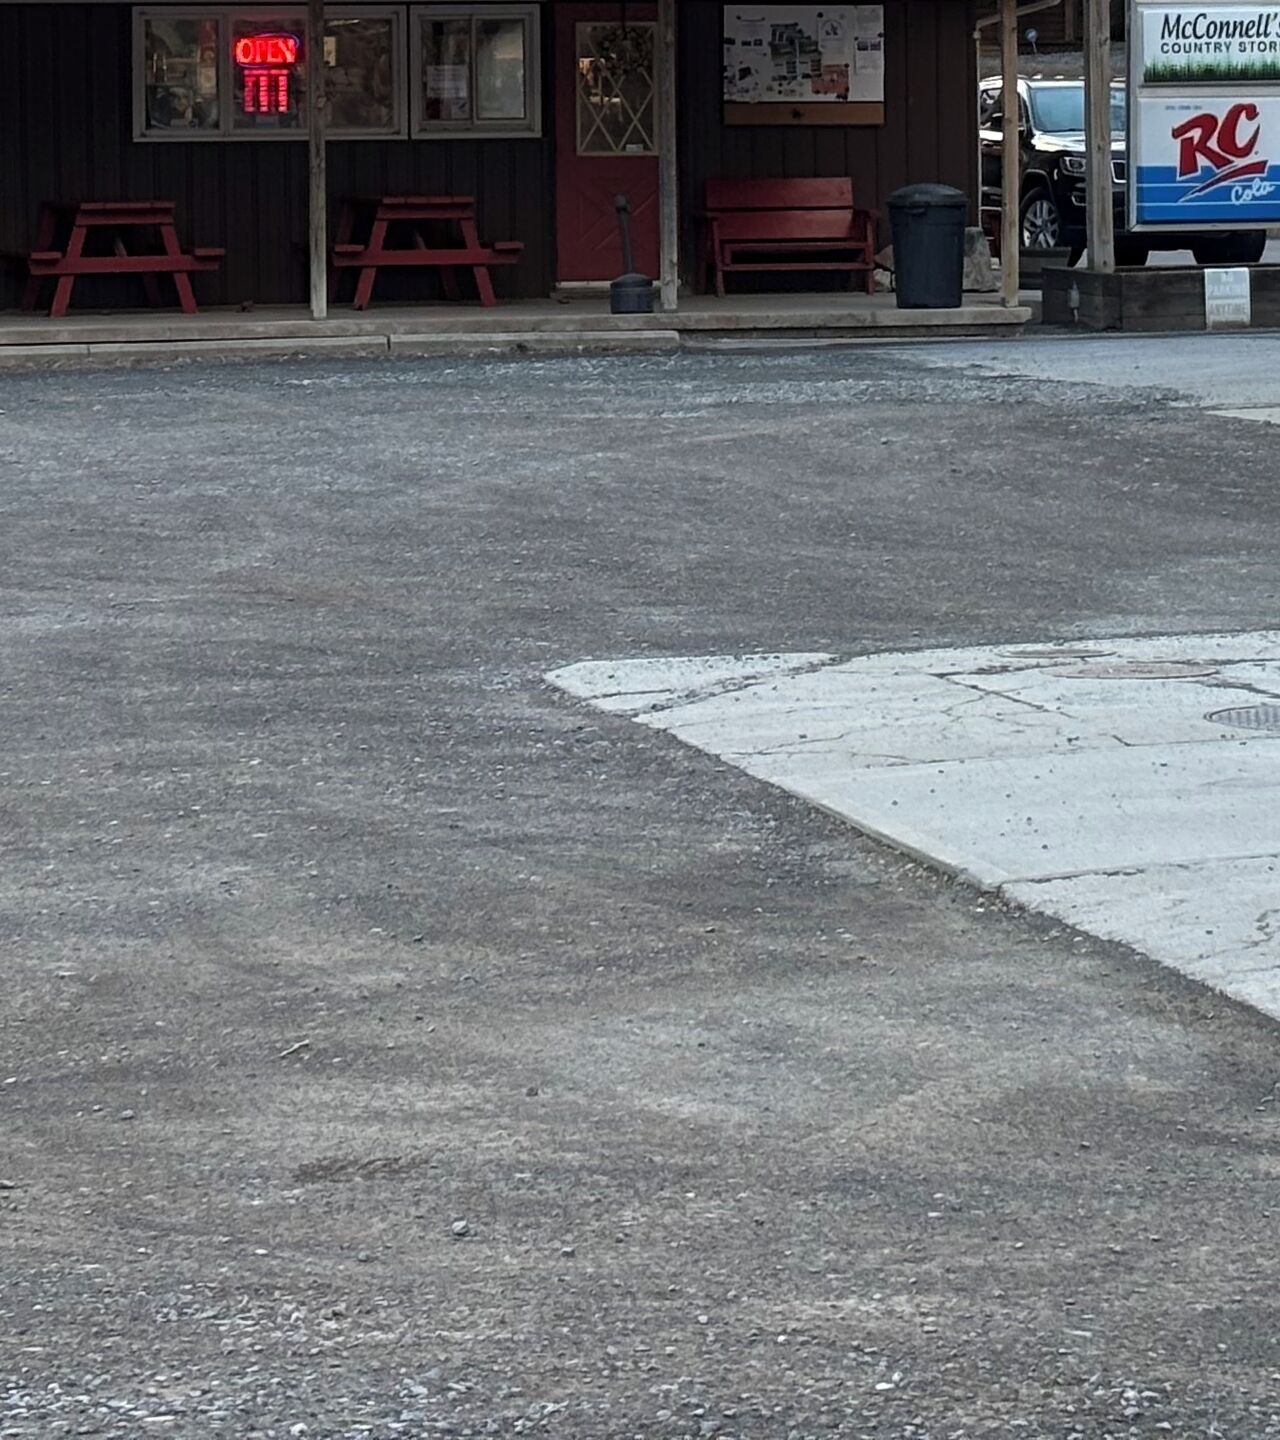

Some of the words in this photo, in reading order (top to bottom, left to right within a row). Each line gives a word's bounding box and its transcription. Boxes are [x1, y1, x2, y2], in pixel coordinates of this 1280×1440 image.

[235, 38, 296, 63] OPEN
[1160, 41, 1232, 54] COUNTRY
[1171, 102, 1261, 178] RC
[1231, 178, 1276, 206] Cola
